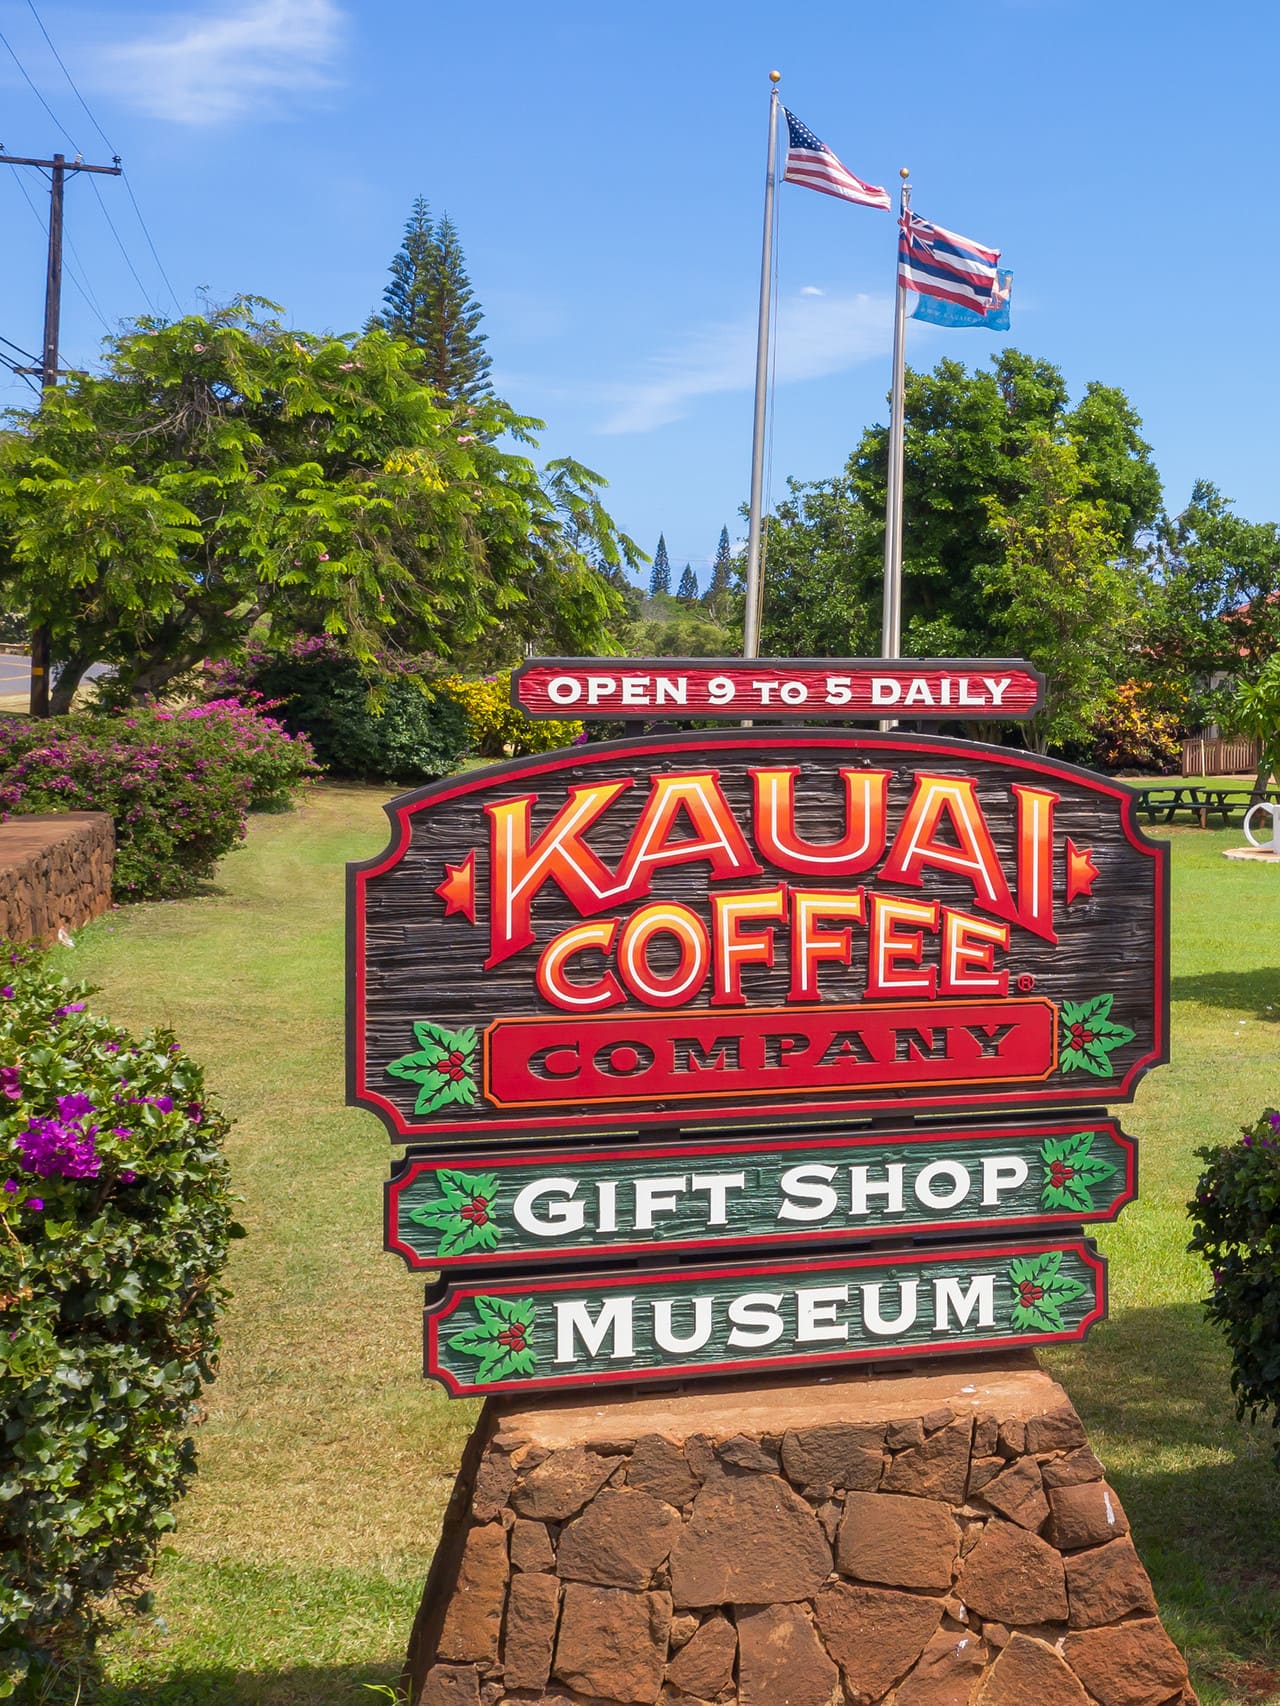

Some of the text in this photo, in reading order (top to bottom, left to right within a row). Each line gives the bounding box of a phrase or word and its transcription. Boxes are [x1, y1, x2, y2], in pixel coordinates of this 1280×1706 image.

[547, 675, 690, 706] OPEN
[708, 676, 735, 705] 9
[825, 676, 852, 705] 5
[871, 678, 1013, 706] DAILY
[484, 768, 1060, 969] KAUAI
[536, 882, 1009, 1011] COFFEE
[527, 1022, 1020, 1081] COMPANY
[513, 1156, 1029, 1237] GIFT SHOP
[553, 1275, 997, 1363] MUSEUM
